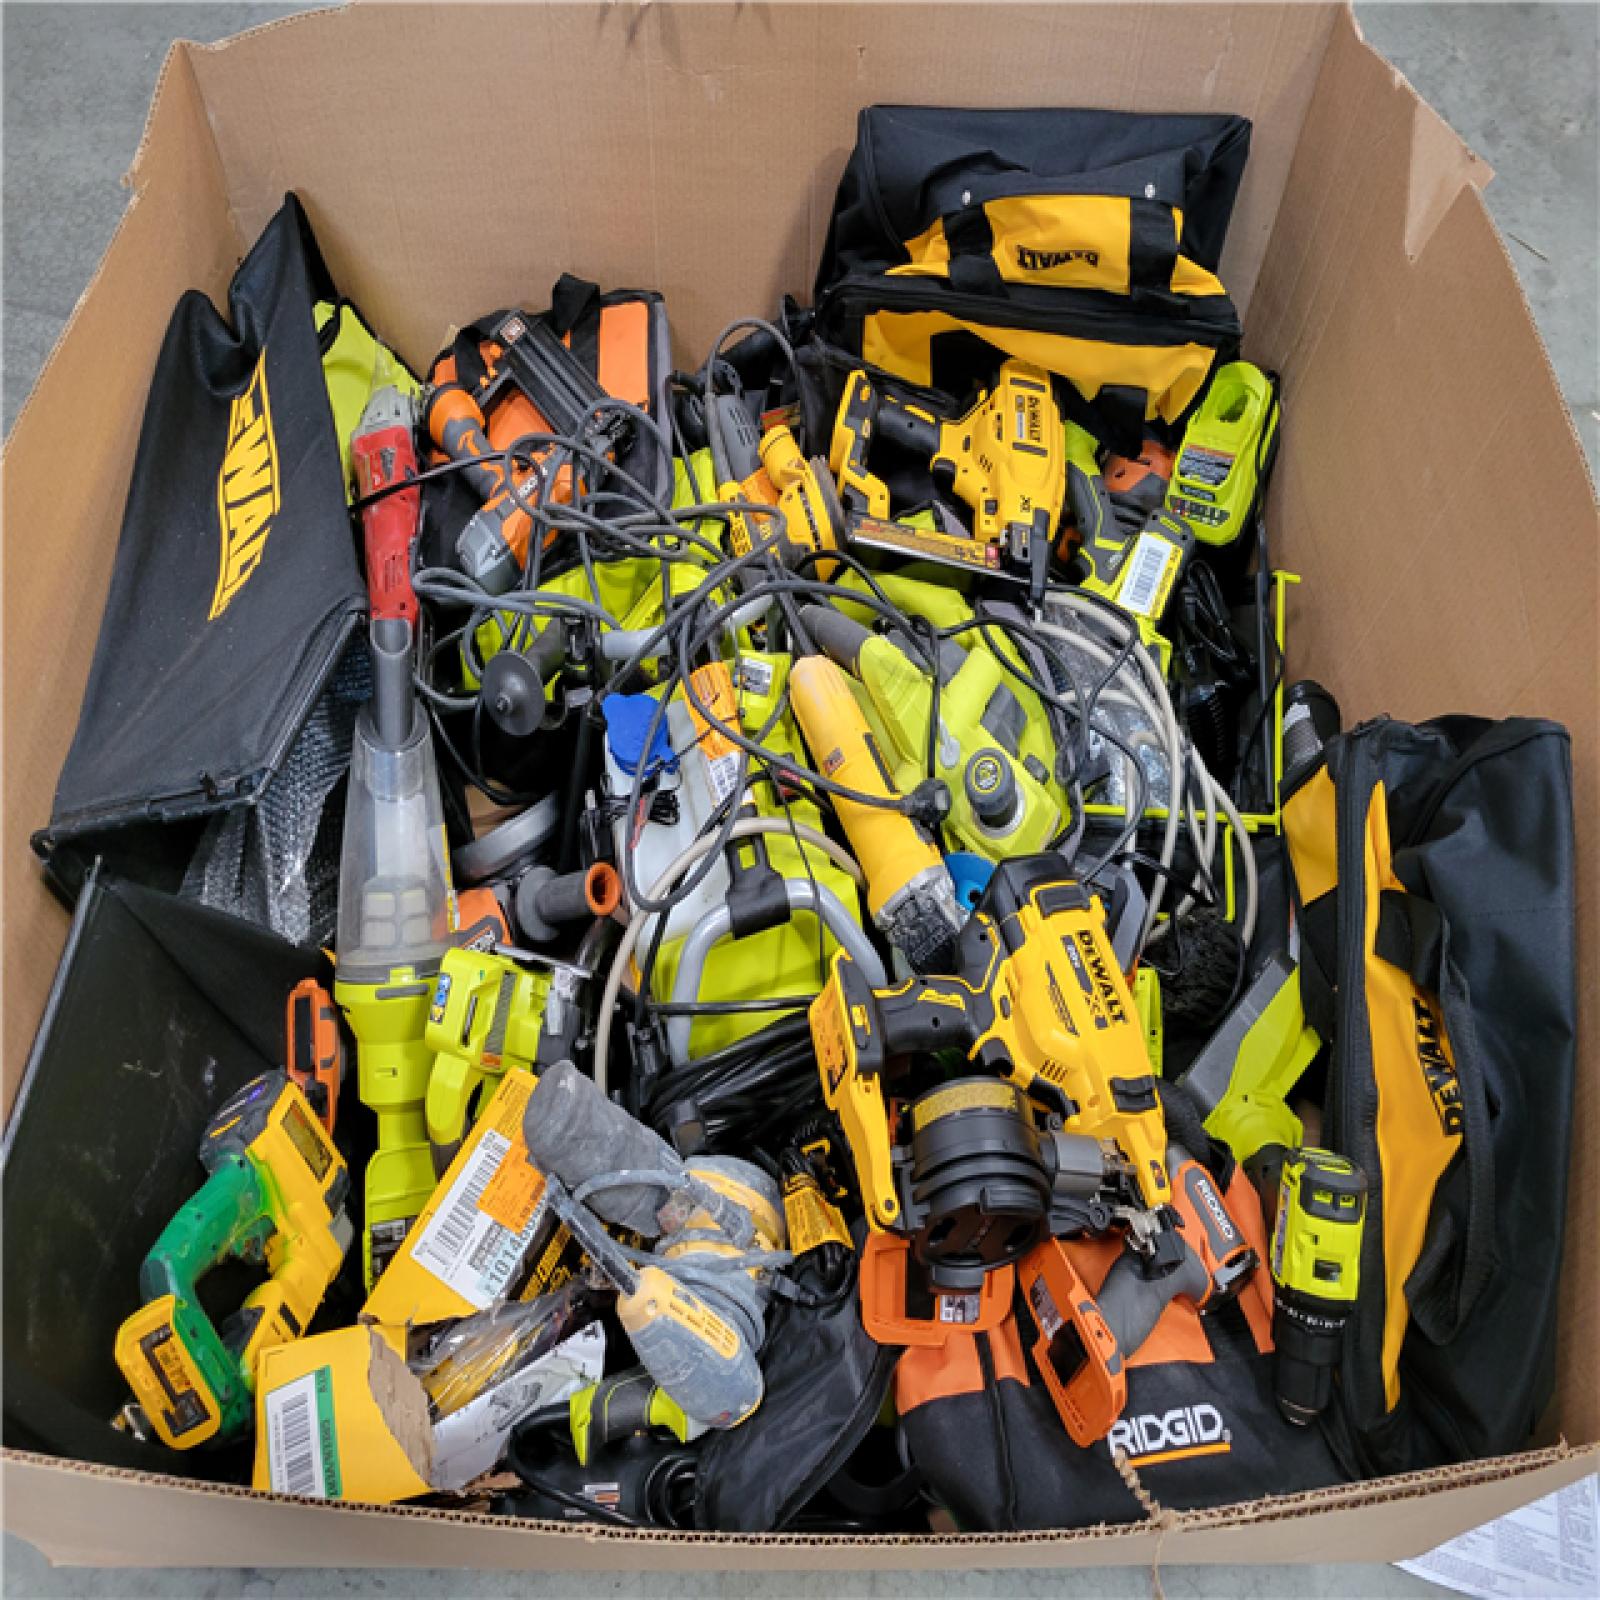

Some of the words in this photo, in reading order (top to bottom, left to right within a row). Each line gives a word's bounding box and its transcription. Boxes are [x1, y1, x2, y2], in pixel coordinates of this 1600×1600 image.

[1015, 244, 1099, 271] DEWALT
[1074, 929, 1130, 1025] DEWALT
[1411, 997, 1466, 1138] DEWALT
[1196, 1180, 1236, 1240] RIDGID
[1107, 1402, 1224, 1459] RIDGID
